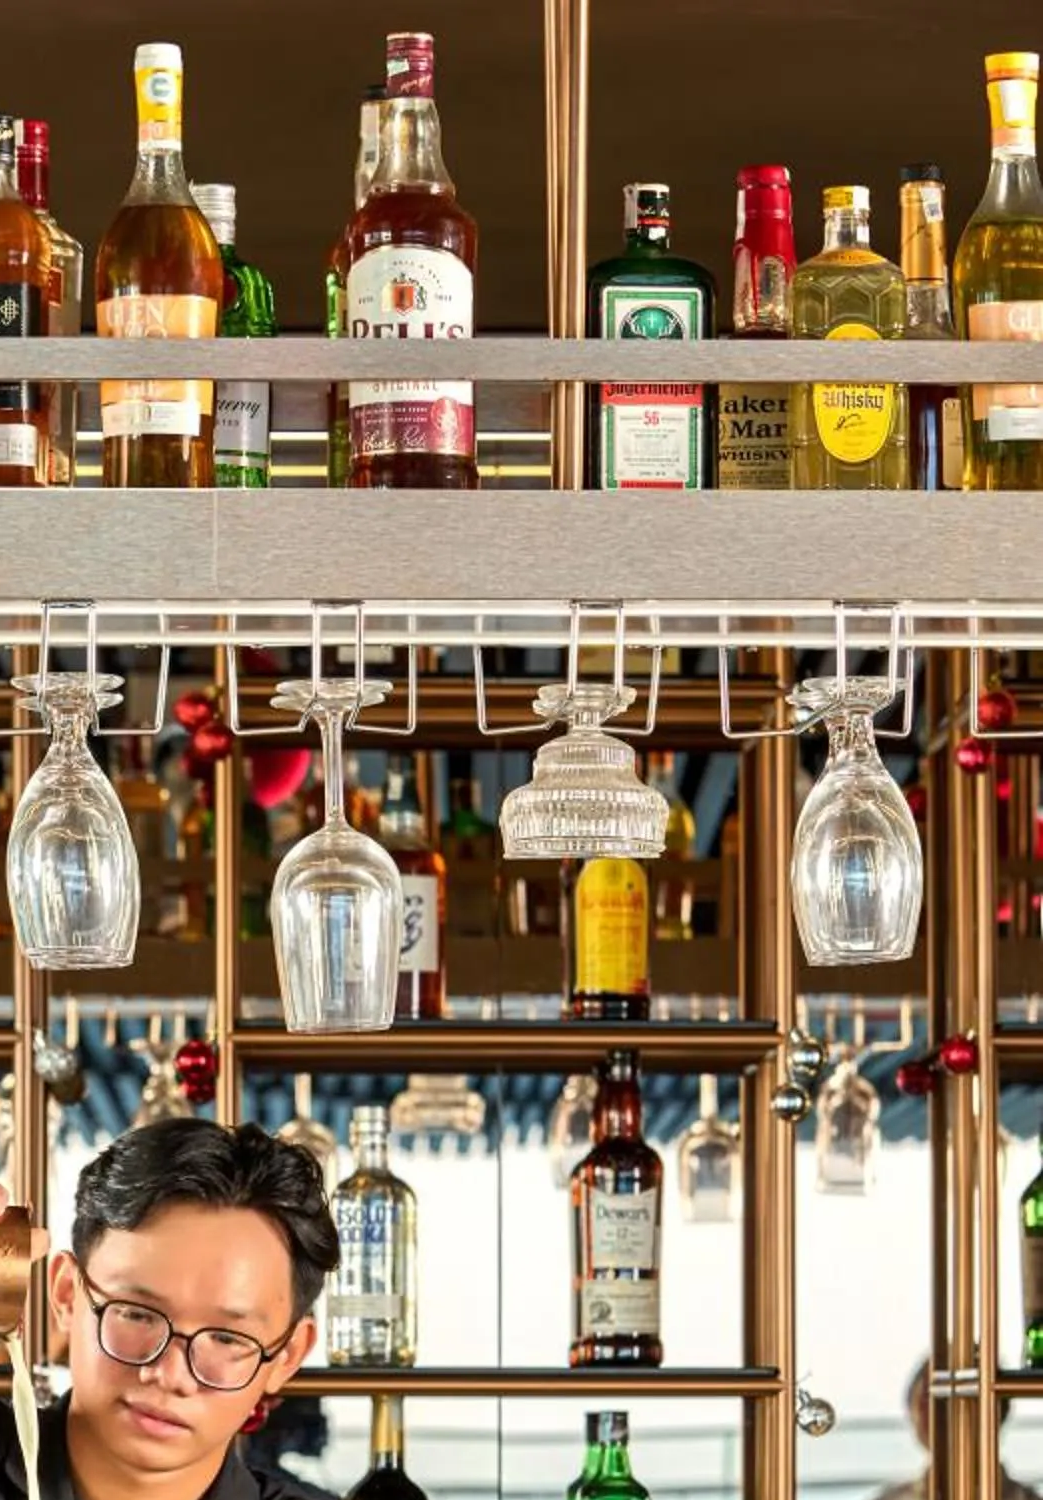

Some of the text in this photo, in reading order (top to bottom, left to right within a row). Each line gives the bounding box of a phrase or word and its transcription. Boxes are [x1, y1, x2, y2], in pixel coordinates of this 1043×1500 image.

[723, 395, 788, 413] aker
[822, 390, 884, 412] Whisky
[643, 410, 660, 425] 56
[729, 420, 788, 438] Mar
[336, 1204, 400, 1224] BSOLUT
[337, 1225, 387, 1243] ODKA
